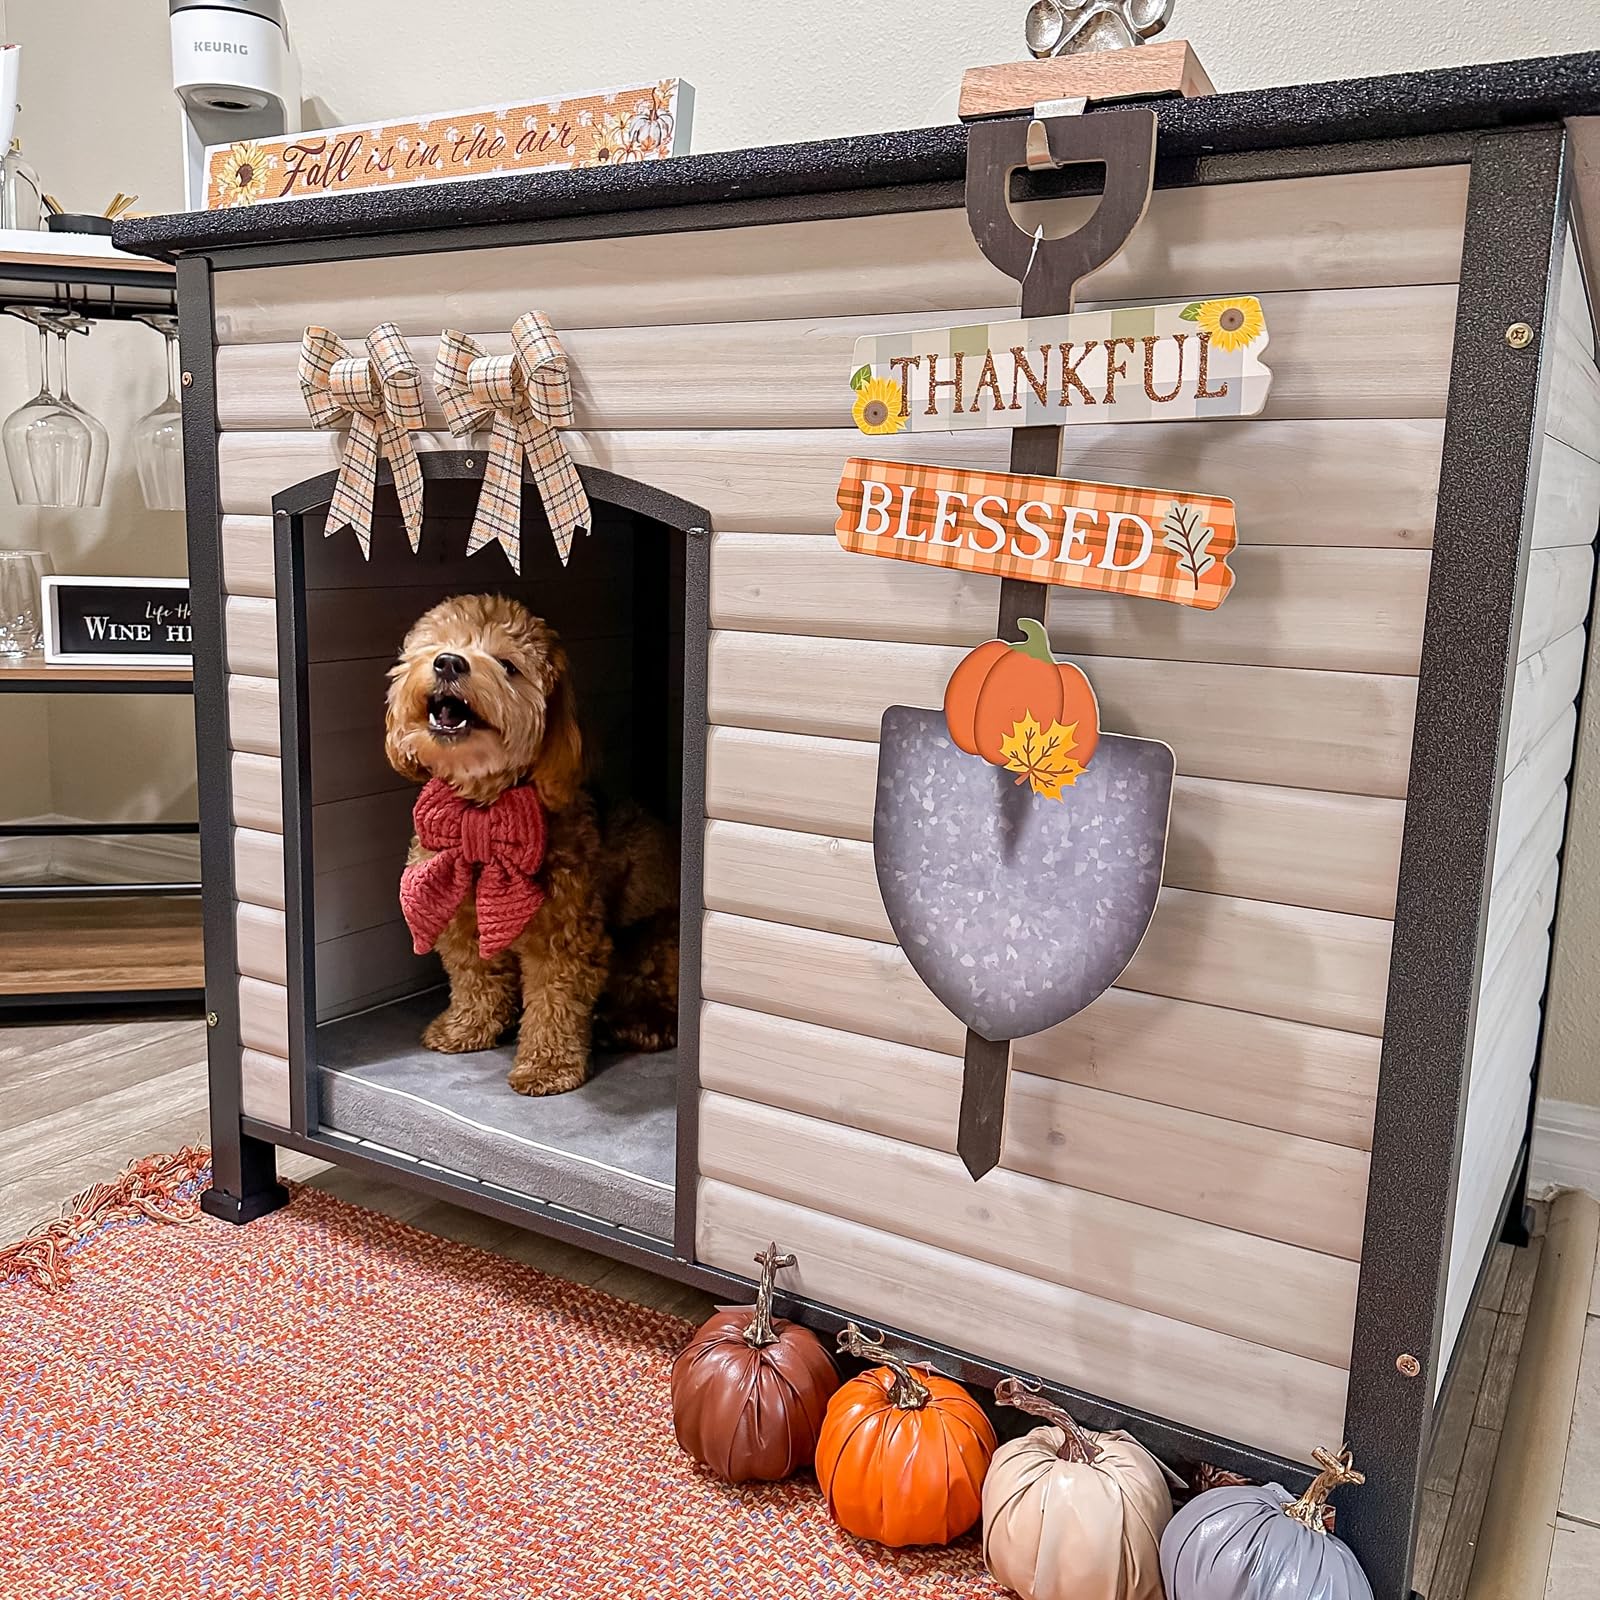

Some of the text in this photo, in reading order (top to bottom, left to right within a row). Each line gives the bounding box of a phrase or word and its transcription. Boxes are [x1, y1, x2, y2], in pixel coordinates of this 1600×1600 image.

[194, 41, 248, 55] KEURIG
[279, 121, 578, 197] Fall is in the air
[890, 331, 1228, 417] THANKFUL
[855, 480, 1153, 572] BLESSED
[83, 616, 151, 641] WINE
[145, 600, 173, 625] Life
